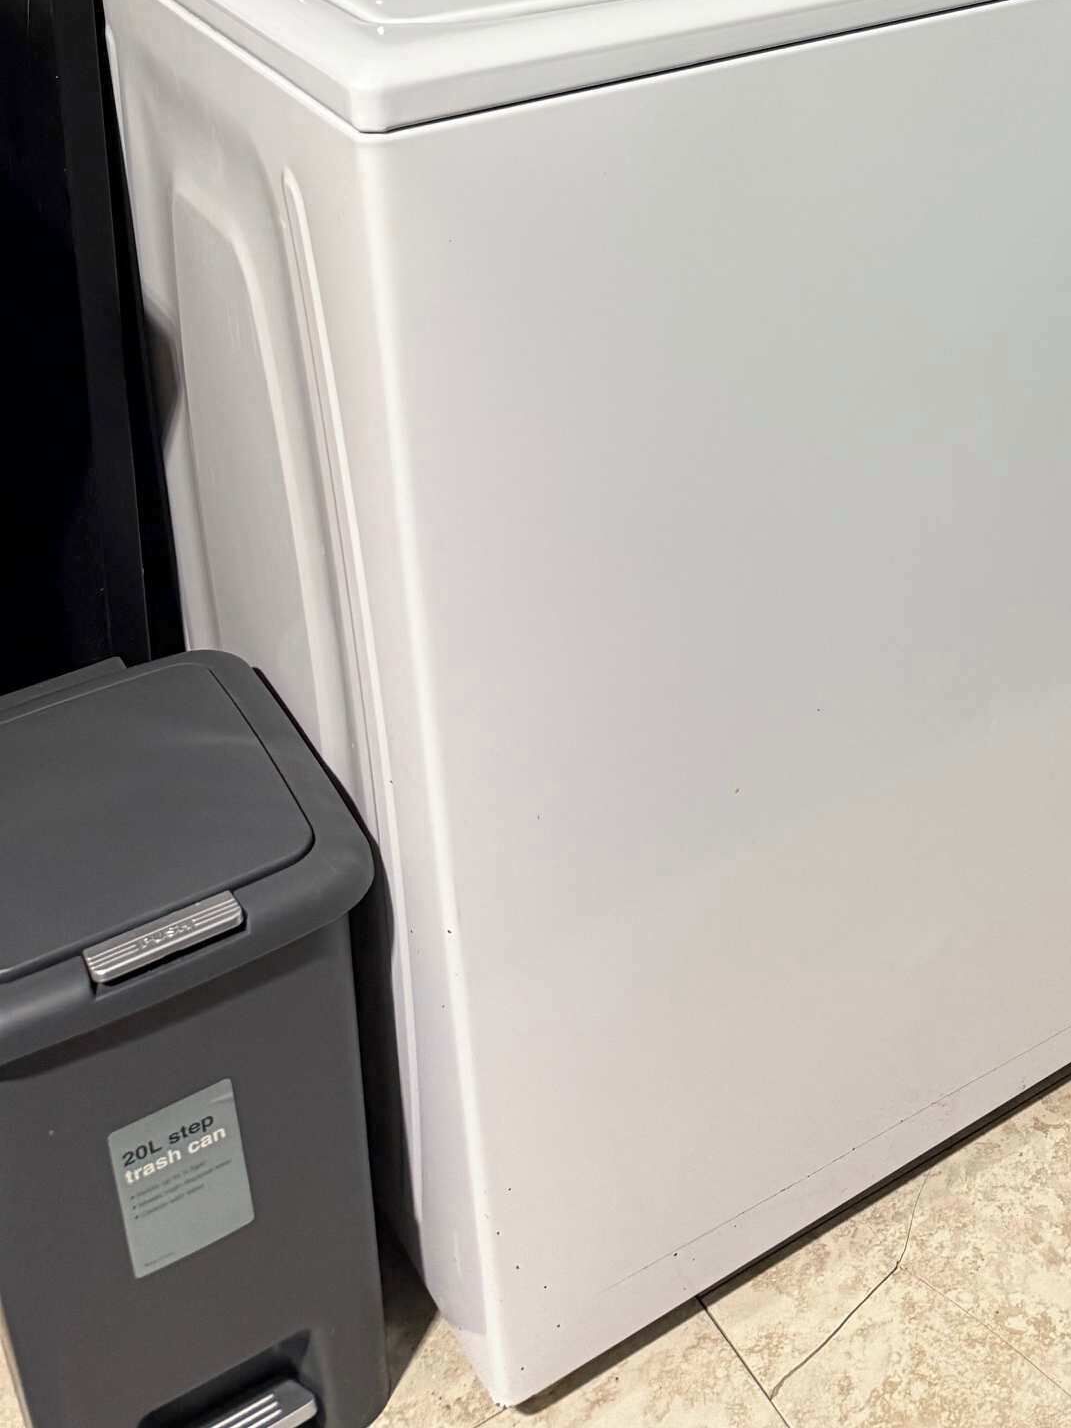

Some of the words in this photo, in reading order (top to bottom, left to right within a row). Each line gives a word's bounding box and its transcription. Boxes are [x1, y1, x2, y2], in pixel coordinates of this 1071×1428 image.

[122, 1140, 163, 1167] 20L
[168, 1115, 215, 1145] step
[124, 1149, 182, 1185] trash
[187, 1127, 227, 1154] can
